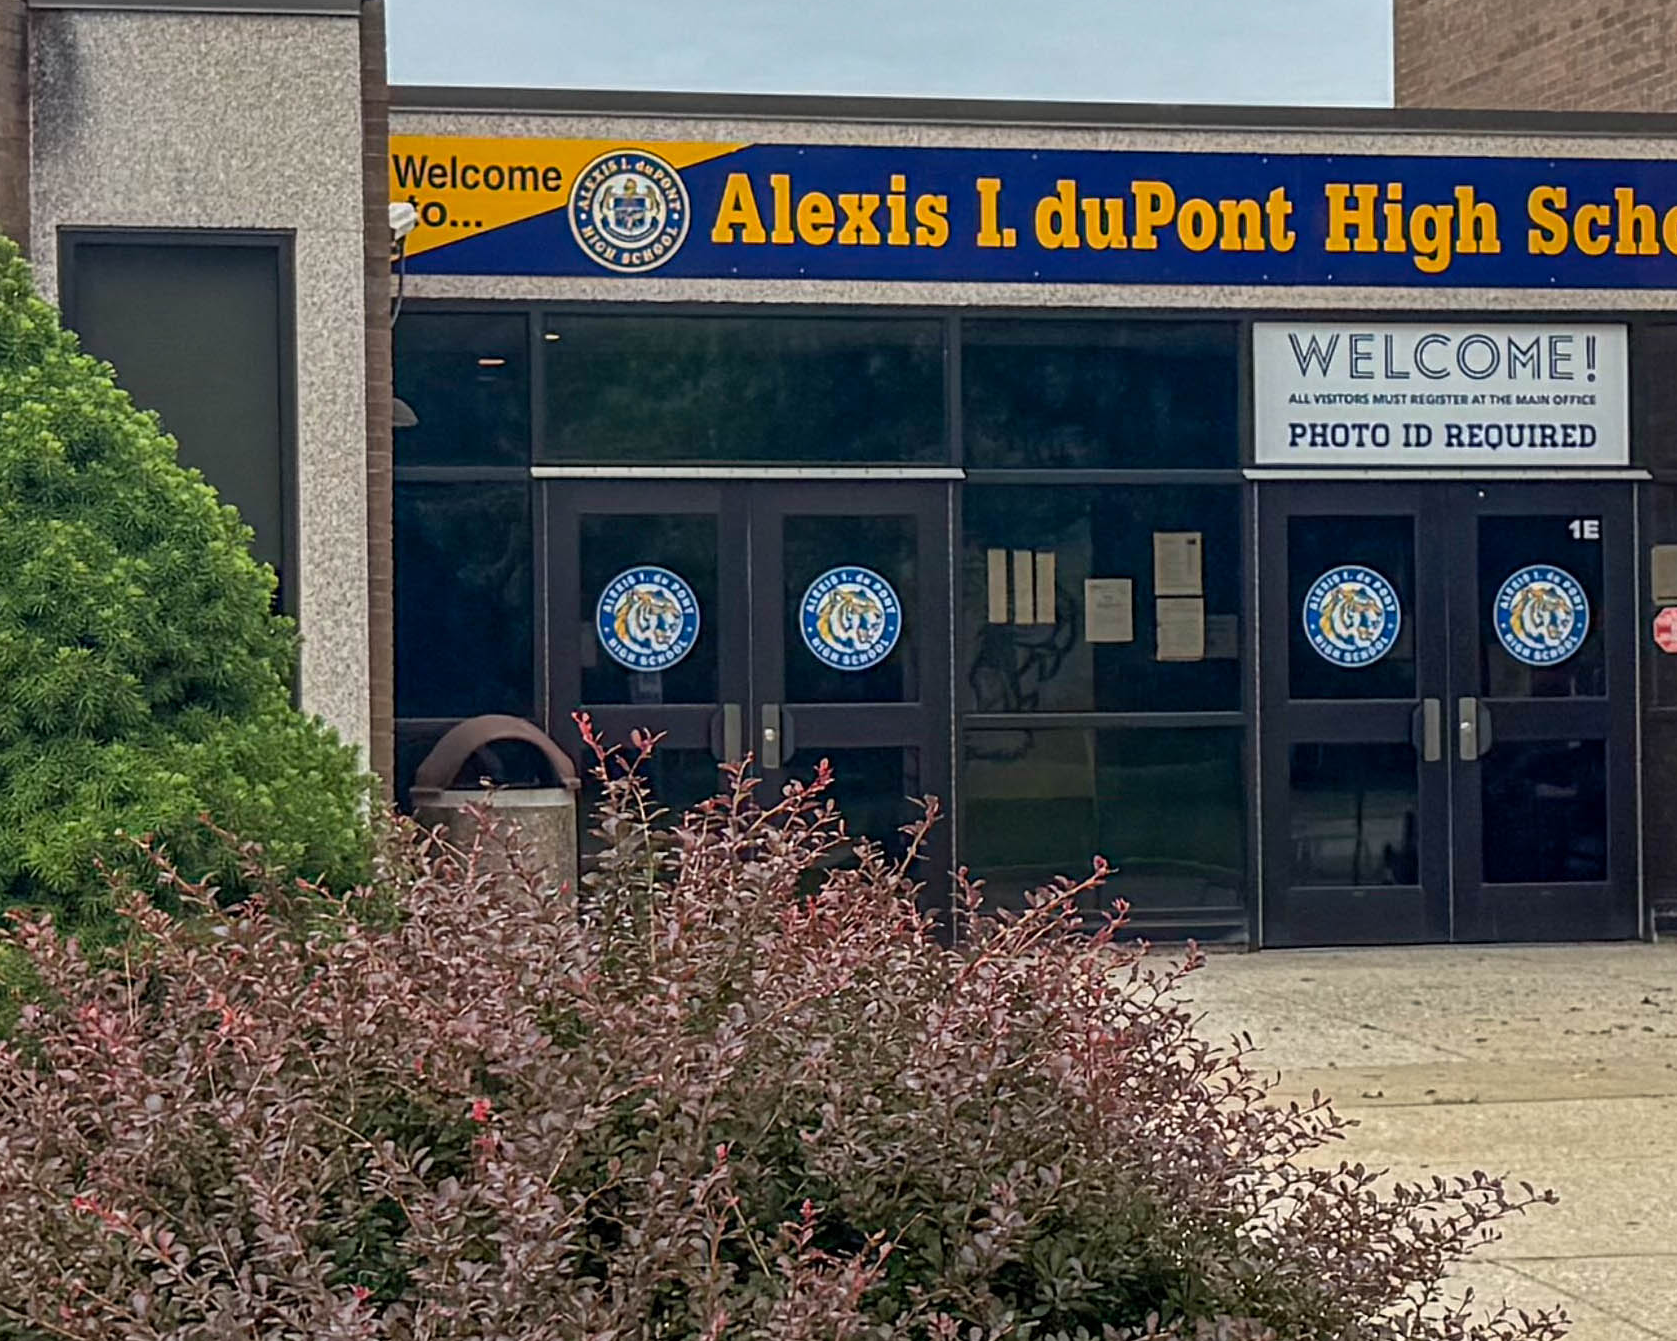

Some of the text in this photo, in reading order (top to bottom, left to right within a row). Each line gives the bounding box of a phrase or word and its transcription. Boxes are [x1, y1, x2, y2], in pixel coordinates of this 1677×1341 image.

[392, 154, 562, 192] Welcome
[577, 160, 618, 211] ALEXIS
[710, 172, 949, 248] Alexis
[975, 177, 1017, 249] I.
[1033, 180, 1297, 253] duPont
[1324, 182, 1501, 273] High
[621, 226, 679, 265] SCHOOL
[1287, 333, 1597, 383] WELCOME!
[1288, 393, 1597, 406] ALL VISITORS MUST REGISTER AT THE MAIN OFFICE
[1288, 422, 1597, 451] PHOTO ID REQUIRED
[1568, 519, 1600, 540] 1E
